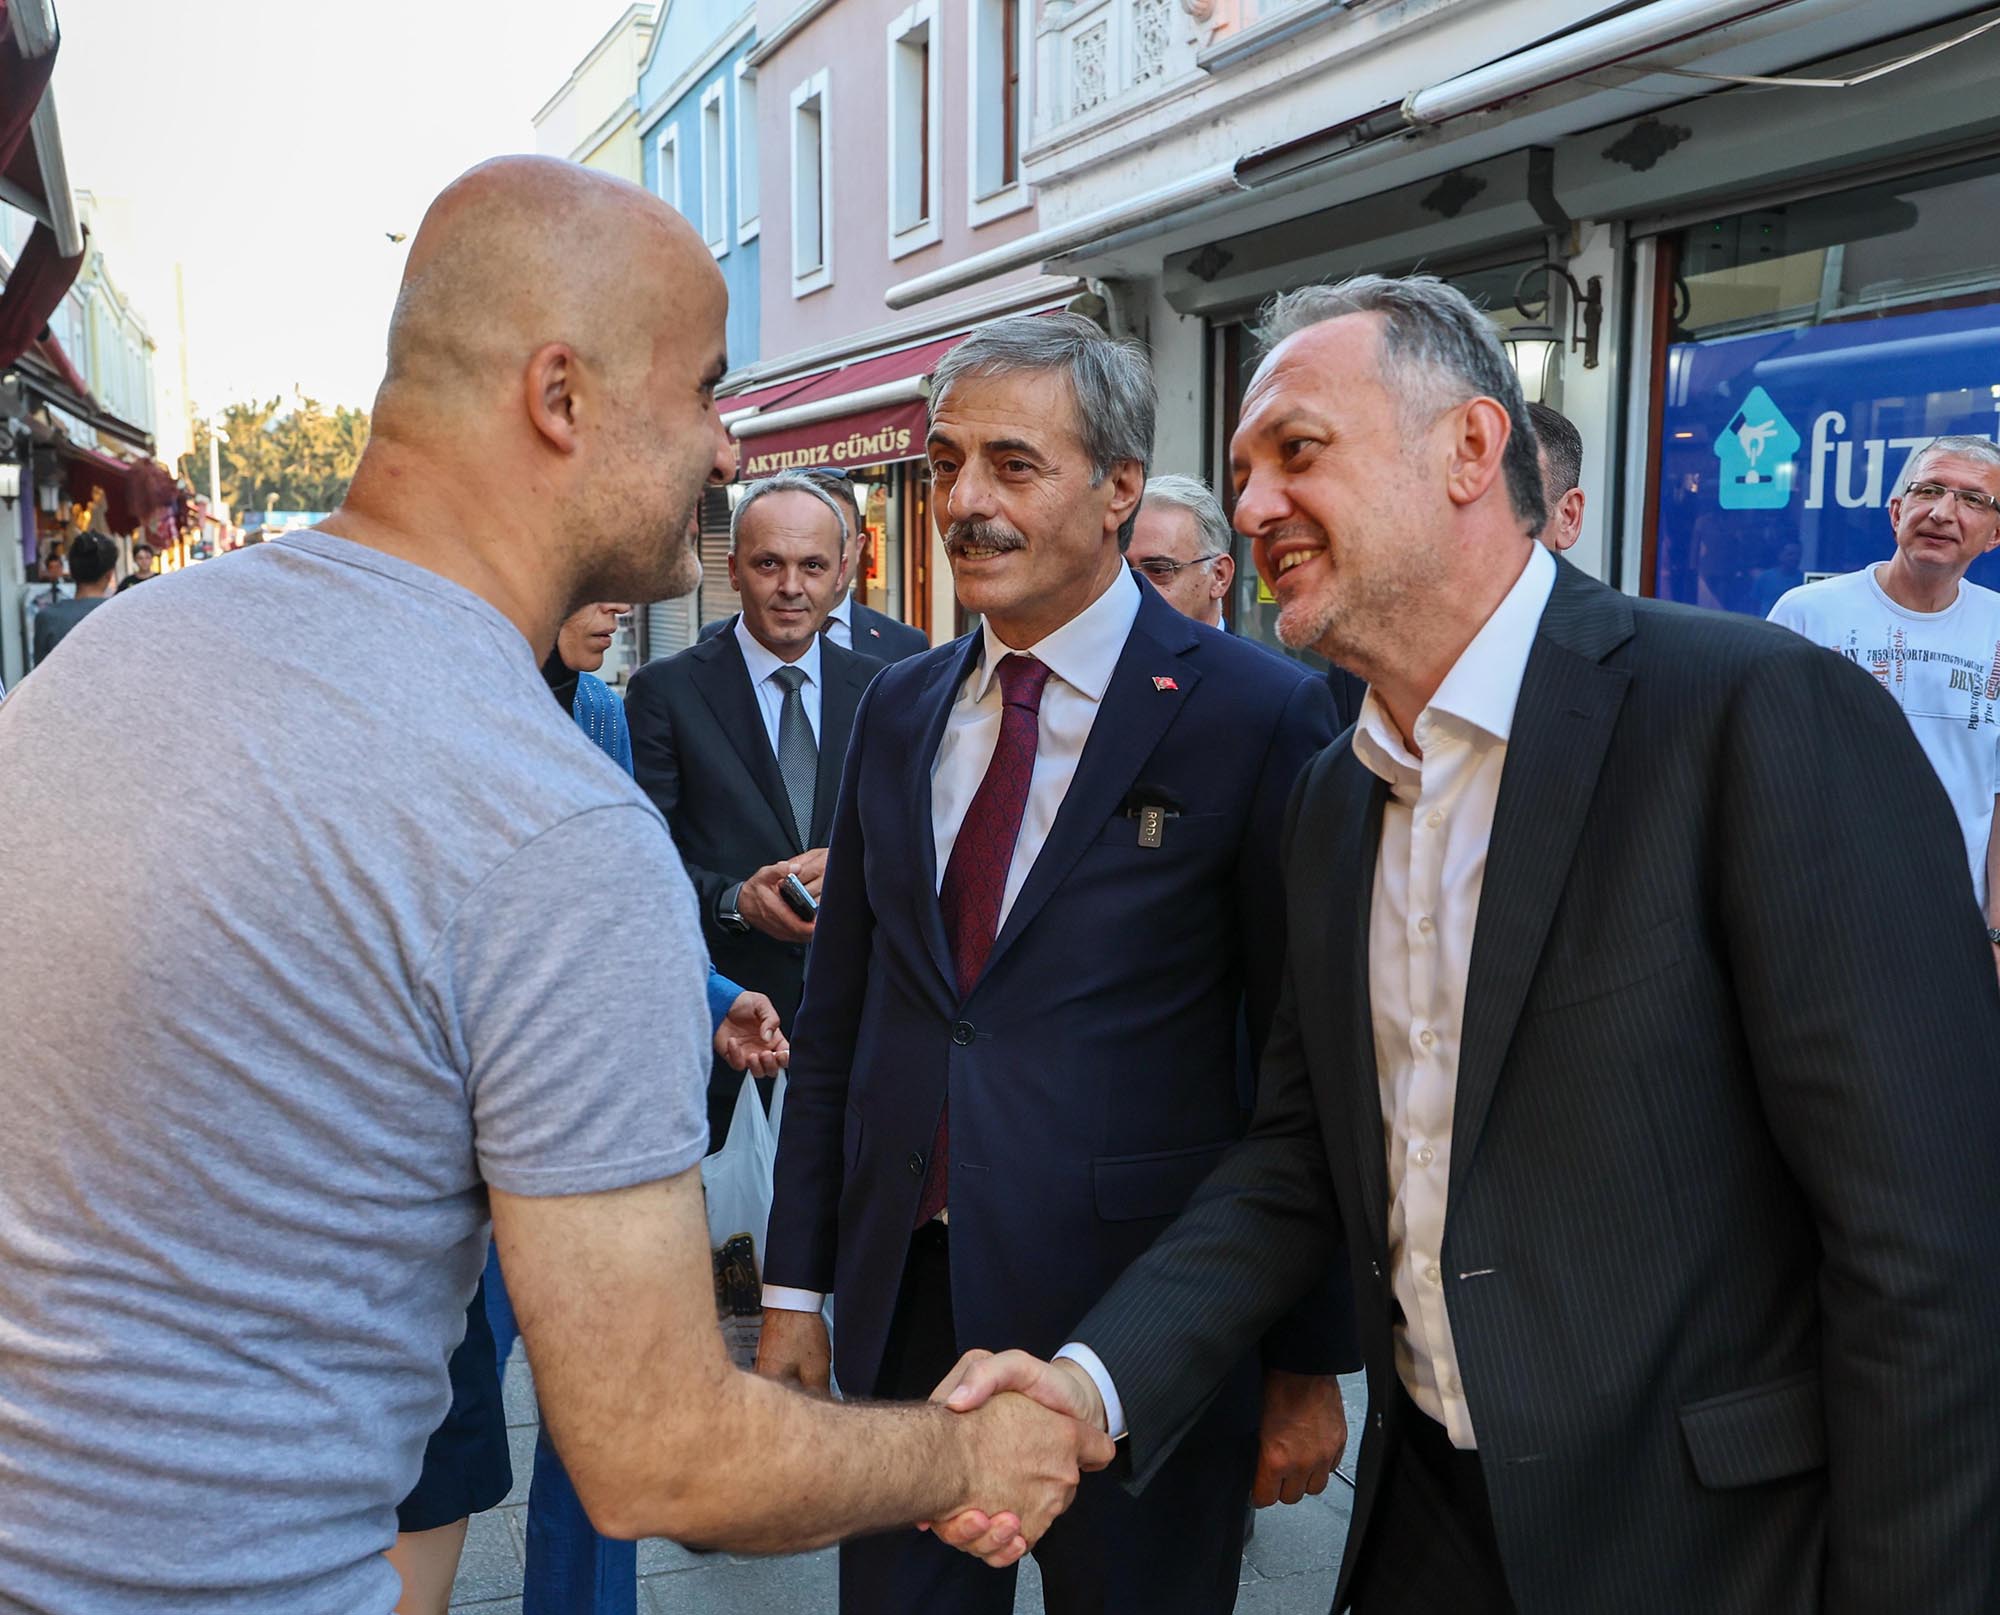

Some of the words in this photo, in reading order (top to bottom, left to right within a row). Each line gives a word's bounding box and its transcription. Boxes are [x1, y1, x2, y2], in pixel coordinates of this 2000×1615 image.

[745, 443, 830, 475] AKYILDIZ
[832, 426, 912, 461] GÜMÜŞ
[1804, 402, 2000, 509] fuz
